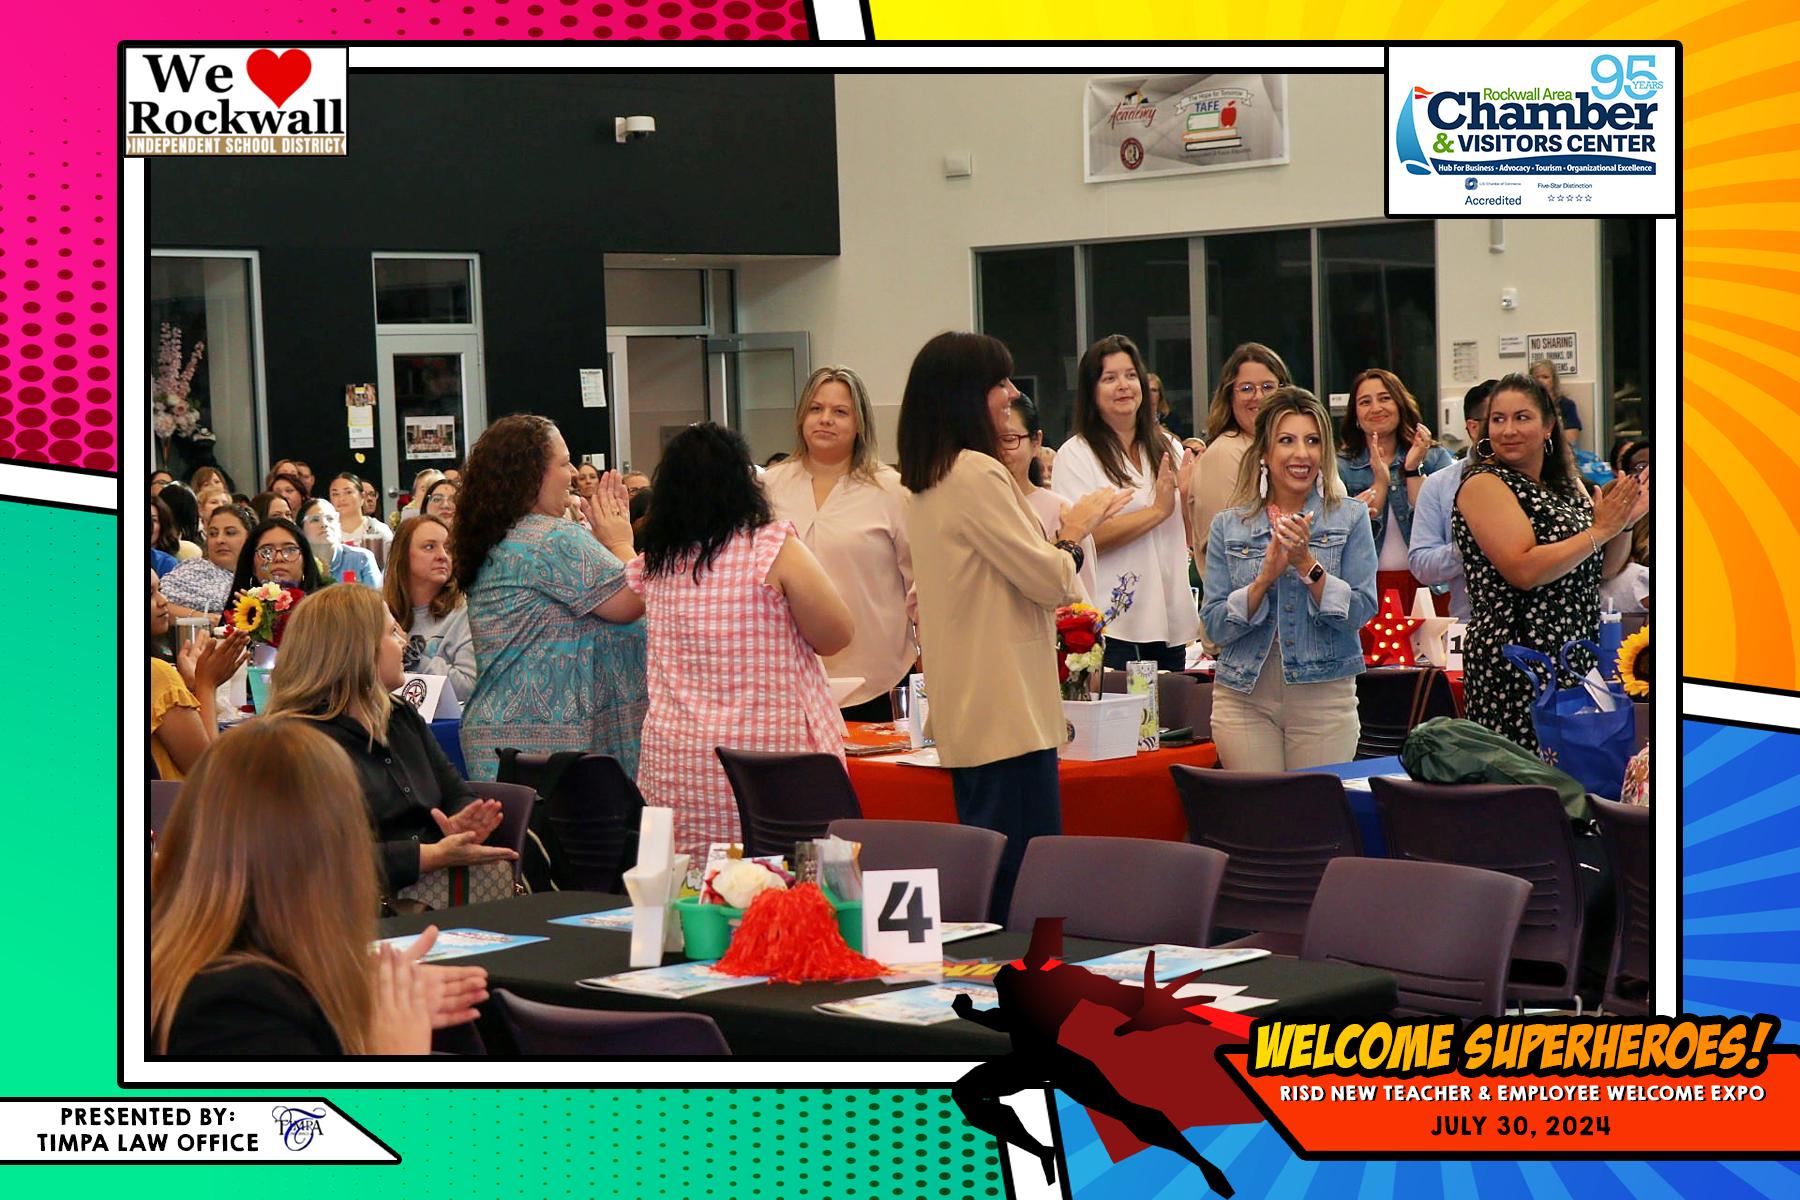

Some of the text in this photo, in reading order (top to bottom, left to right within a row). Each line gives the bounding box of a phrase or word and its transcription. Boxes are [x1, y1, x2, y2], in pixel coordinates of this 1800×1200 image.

[1195, 101, 1220, 112] TAFE
[1531, 338, 1541, 350] NO
[1542, 336, 1573, 349] SHARING
[877, 881, 933, 944] 4
